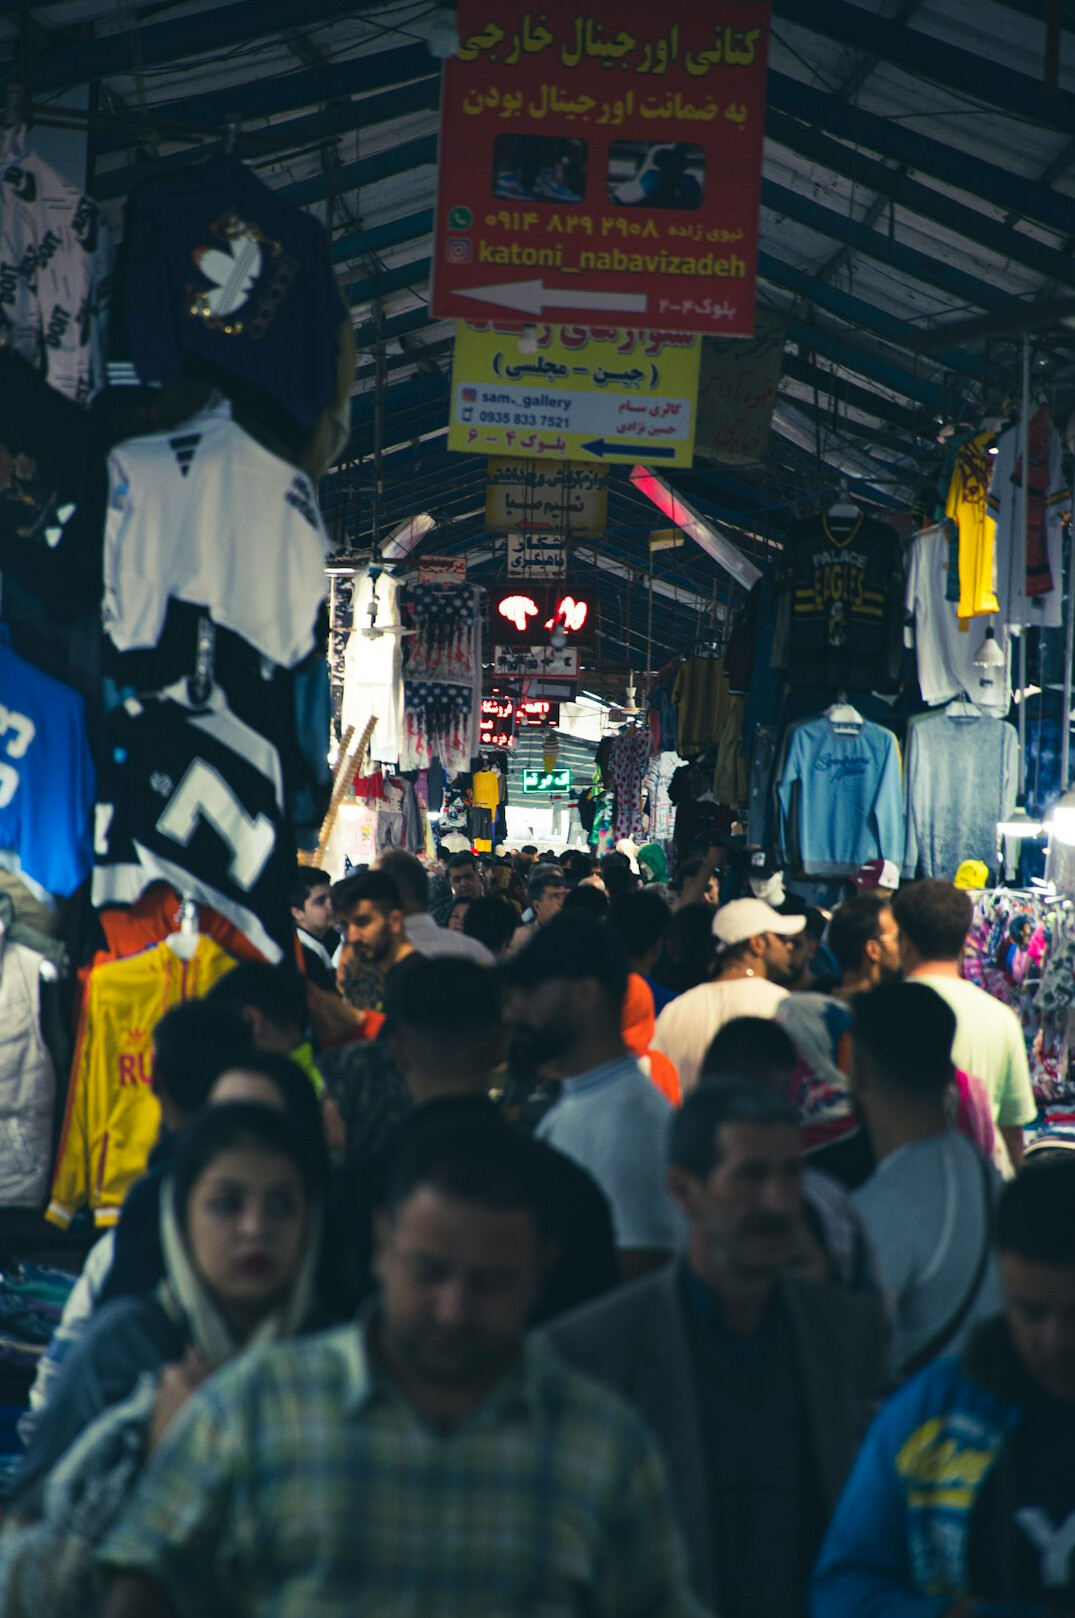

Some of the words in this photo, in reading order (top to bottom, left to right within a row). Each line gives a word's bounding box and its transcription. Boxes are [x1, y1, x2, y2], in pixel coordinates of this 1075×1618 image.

[456, 12, 555, 65] خارجی
[560, 15, 680, 75] اورجینال
[685, 24, 762, 76] کتانی
[462, 86, 523, 118] بودن
[528, 82, 635, 126] اورجینال
[640, 90, 718, 122] ضمانت
[724, 100, 747, 130] به
[478, 239, 747, 278] katoni_nabavizadeh
[479, 410, 511, 424] 0935
[513, 414, 537, 426] 833
[540, 415, 570, 429] 7521
[520, 434, 566, 454] بلوک
[505, 492, 543, 517] صبا
[544, 495, 584, 518] نسیم
[511, 536, 565, 552] شکار
[812, 549, 868, 570] PALACE
